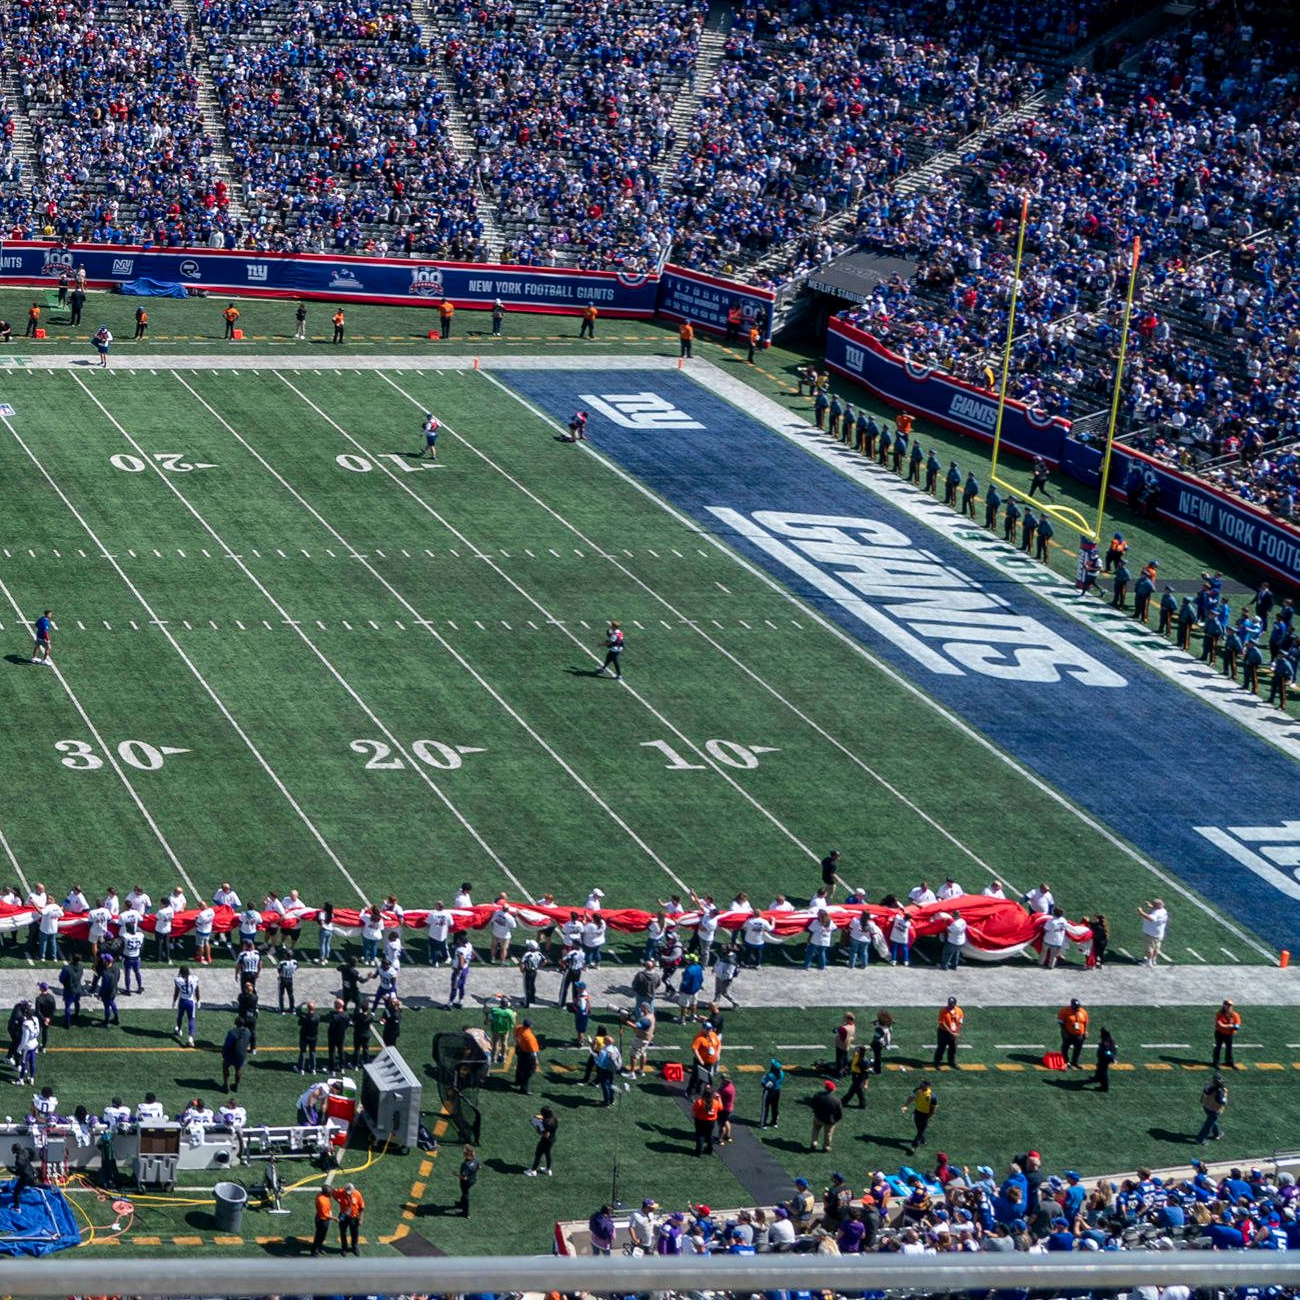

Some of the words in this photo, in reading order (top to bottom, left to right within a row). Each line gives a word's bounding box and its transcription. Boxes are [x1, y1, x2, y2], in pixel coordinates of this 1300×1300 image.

[469, 279, 492, 292] NEW
[496, 281, 521, 294] YORK
[525, 284, 572, 298] FOOTBALL
[576, 287, 614, 301] GIANTS
[949, 394, 998, 427] GIANTS
[109, 453, 195, 472] 20
[335, 453, 424, 472] 10
[1179, 491, 1215, 524] NEW
[1218, 509, 1256, 547] YORK
[740, 511, 1130, 688] GIANTS
[54, 739, 164, 770] 30
[349, 739, 462, 770] 20
[639, 738, 759, 770] 10
[669, 1066, 681, 1080] 20
[1049, 1054, 1064, 1069] 10
